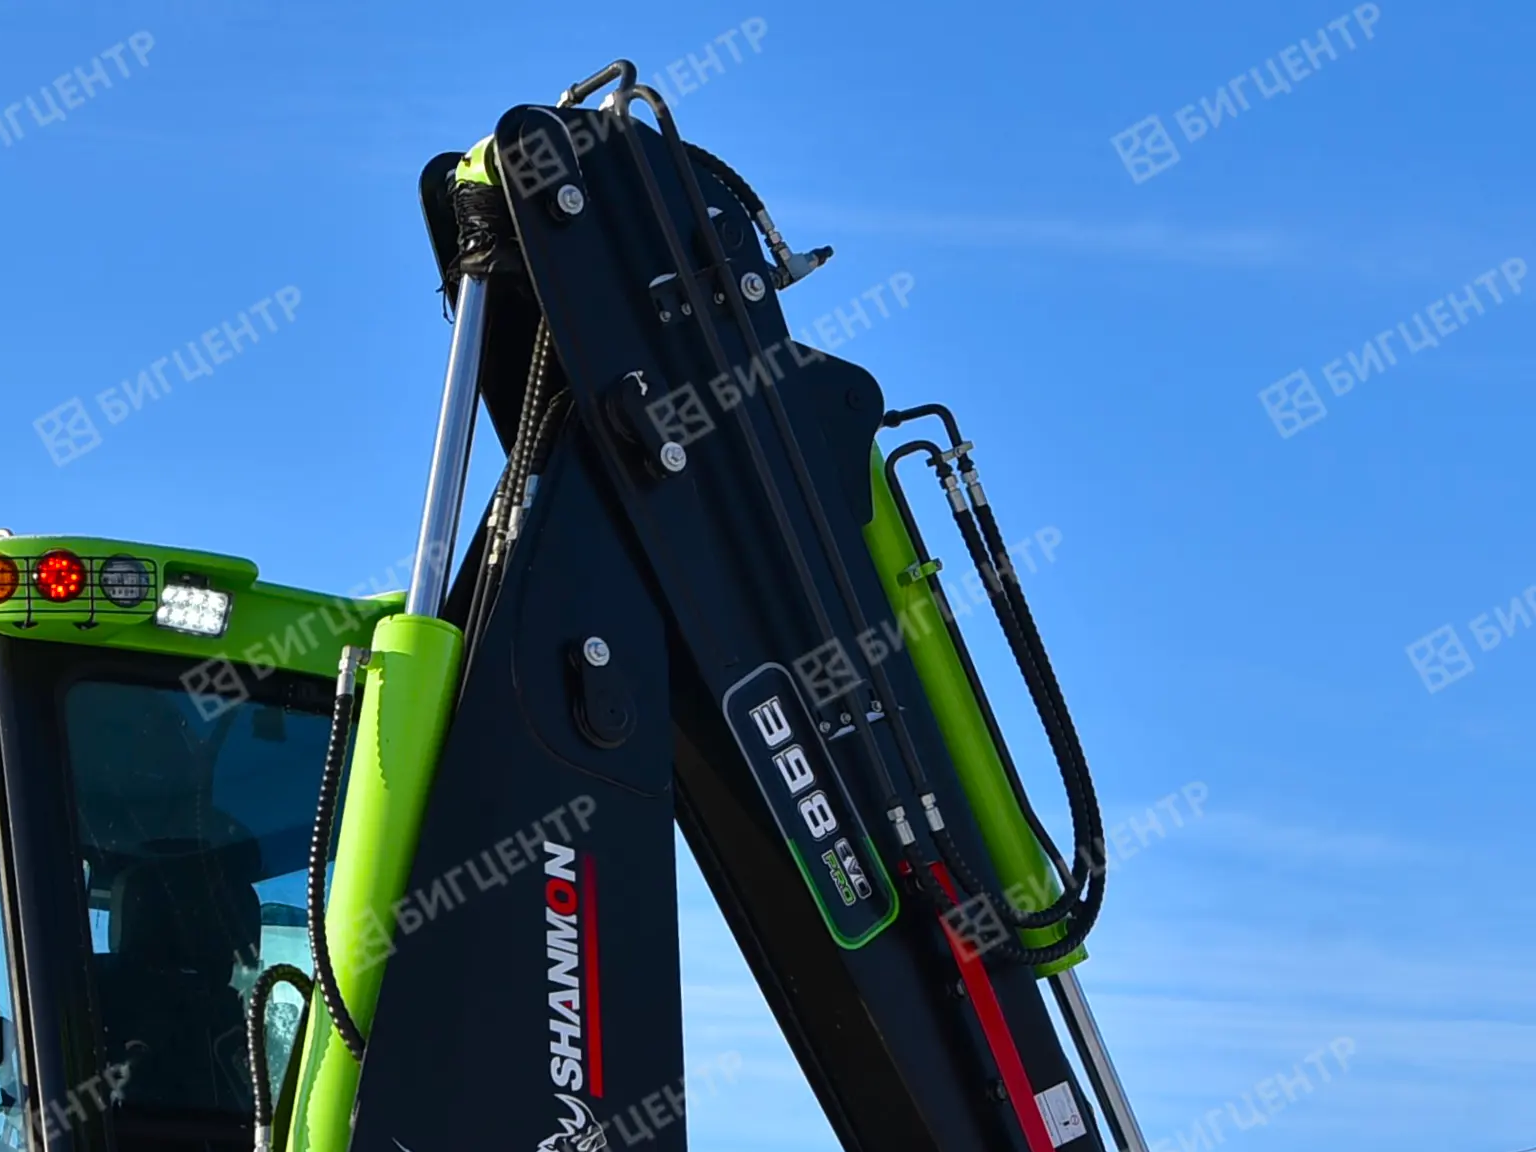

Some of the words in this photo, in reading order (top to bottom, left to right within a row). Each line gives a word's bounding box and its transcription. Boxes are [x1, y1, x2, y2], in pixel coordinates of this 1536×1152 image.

[749, 695, 839, 841] 398
[821, 849, 856, 906] PRO
[834, 837, 872, 899] EVO
[543, 841, 584, 1092] SHANMON
